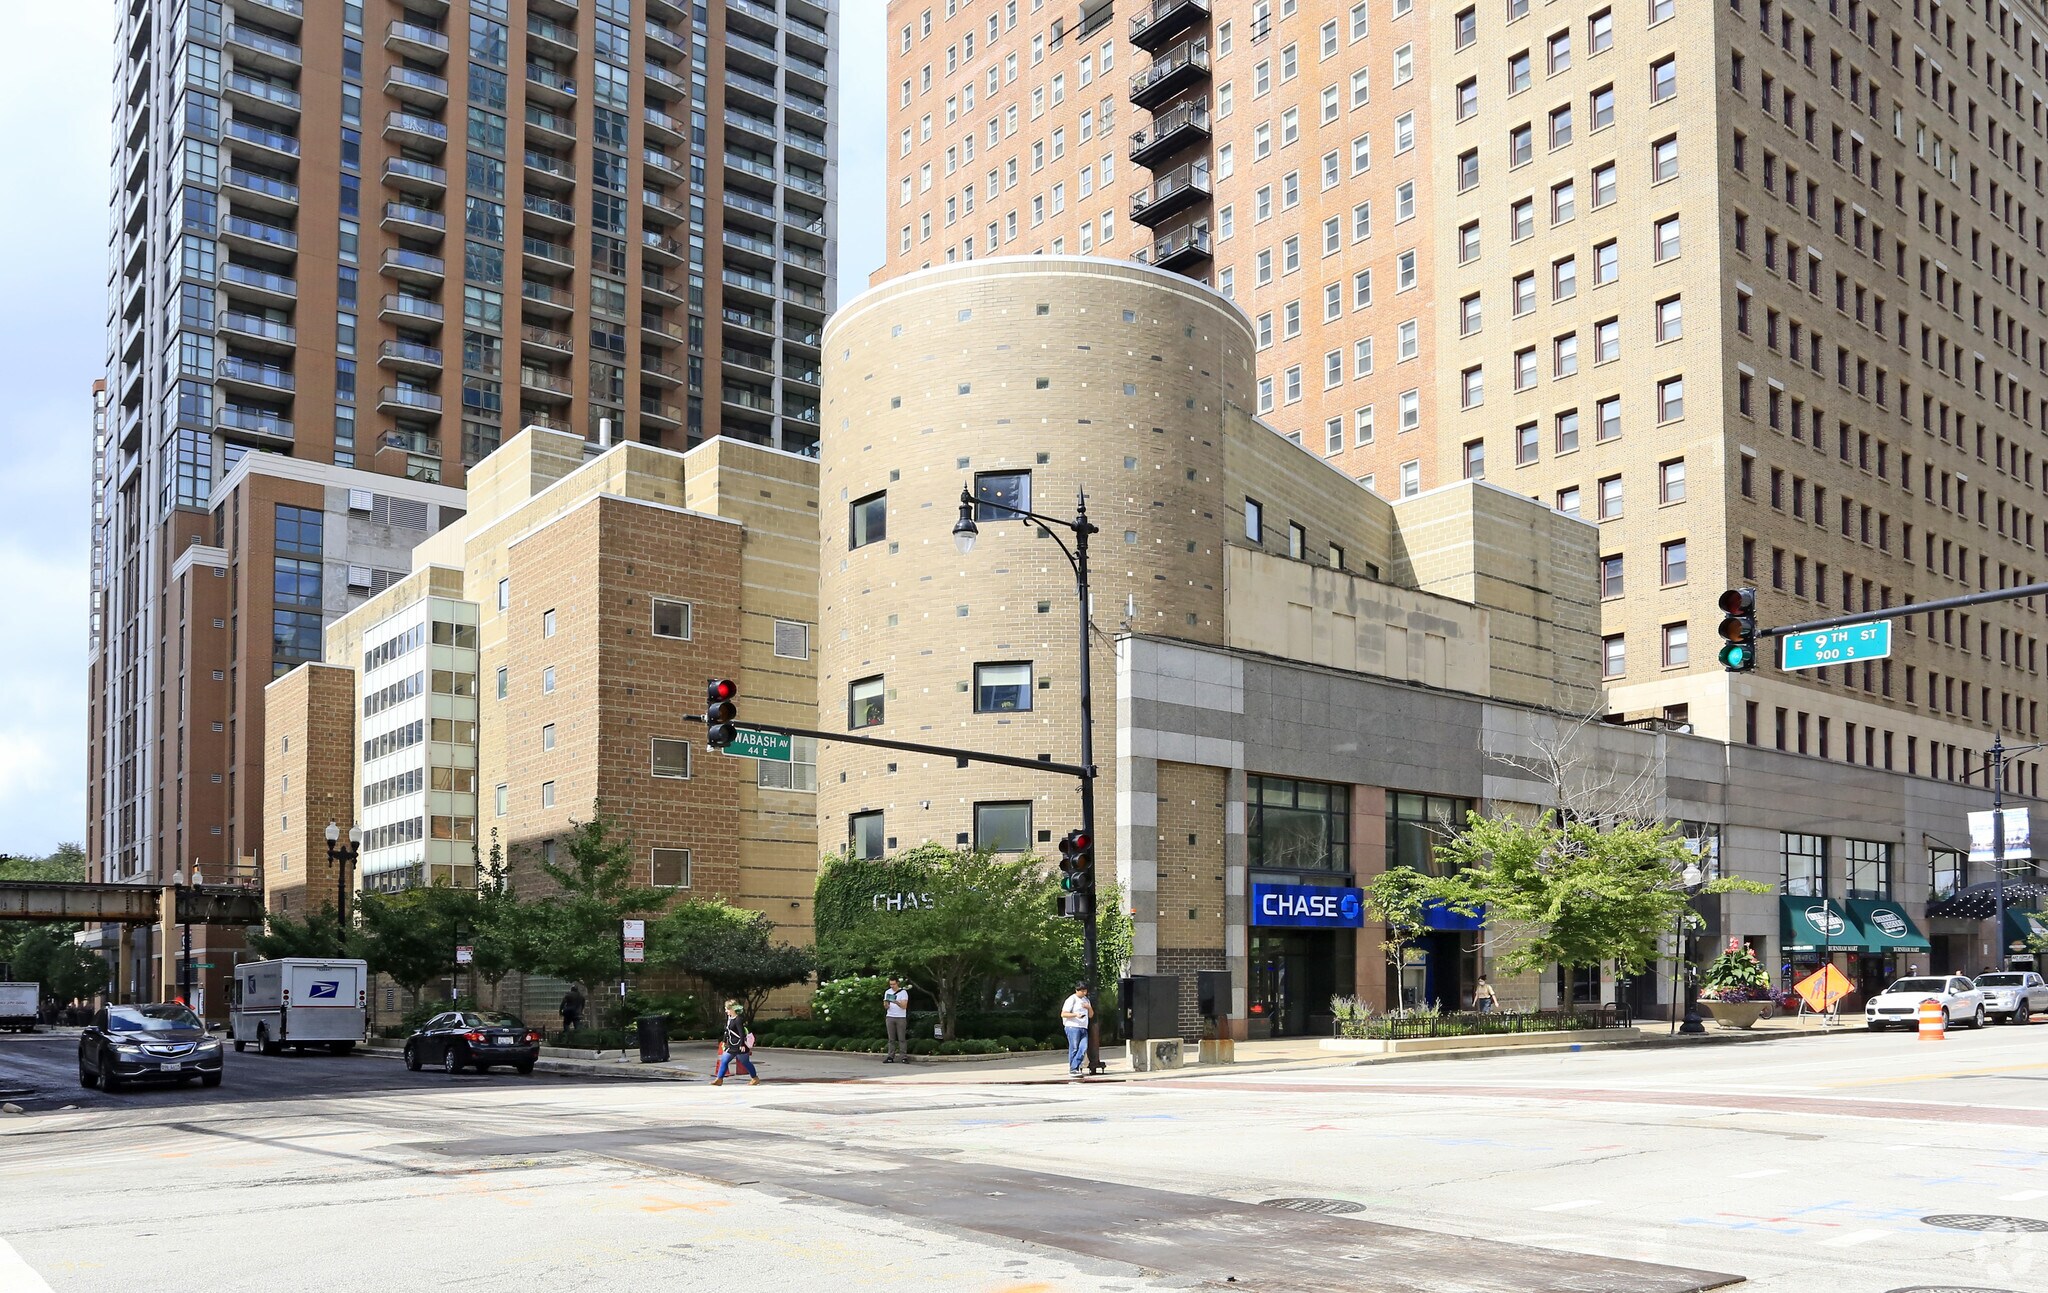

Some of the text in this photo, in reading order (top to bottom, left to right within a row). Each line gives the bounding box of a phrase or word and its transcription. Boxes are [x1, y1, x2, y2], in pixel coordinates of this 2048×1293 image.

[1794, 628, 1877, 650] E 9TH ST
[1815, 646, 1855, 661] 900 S
[747, 746, 768, 756] 44 E
[778, 739, 789, 748] AV
[1262, 894, 1338, 917] CHASE
